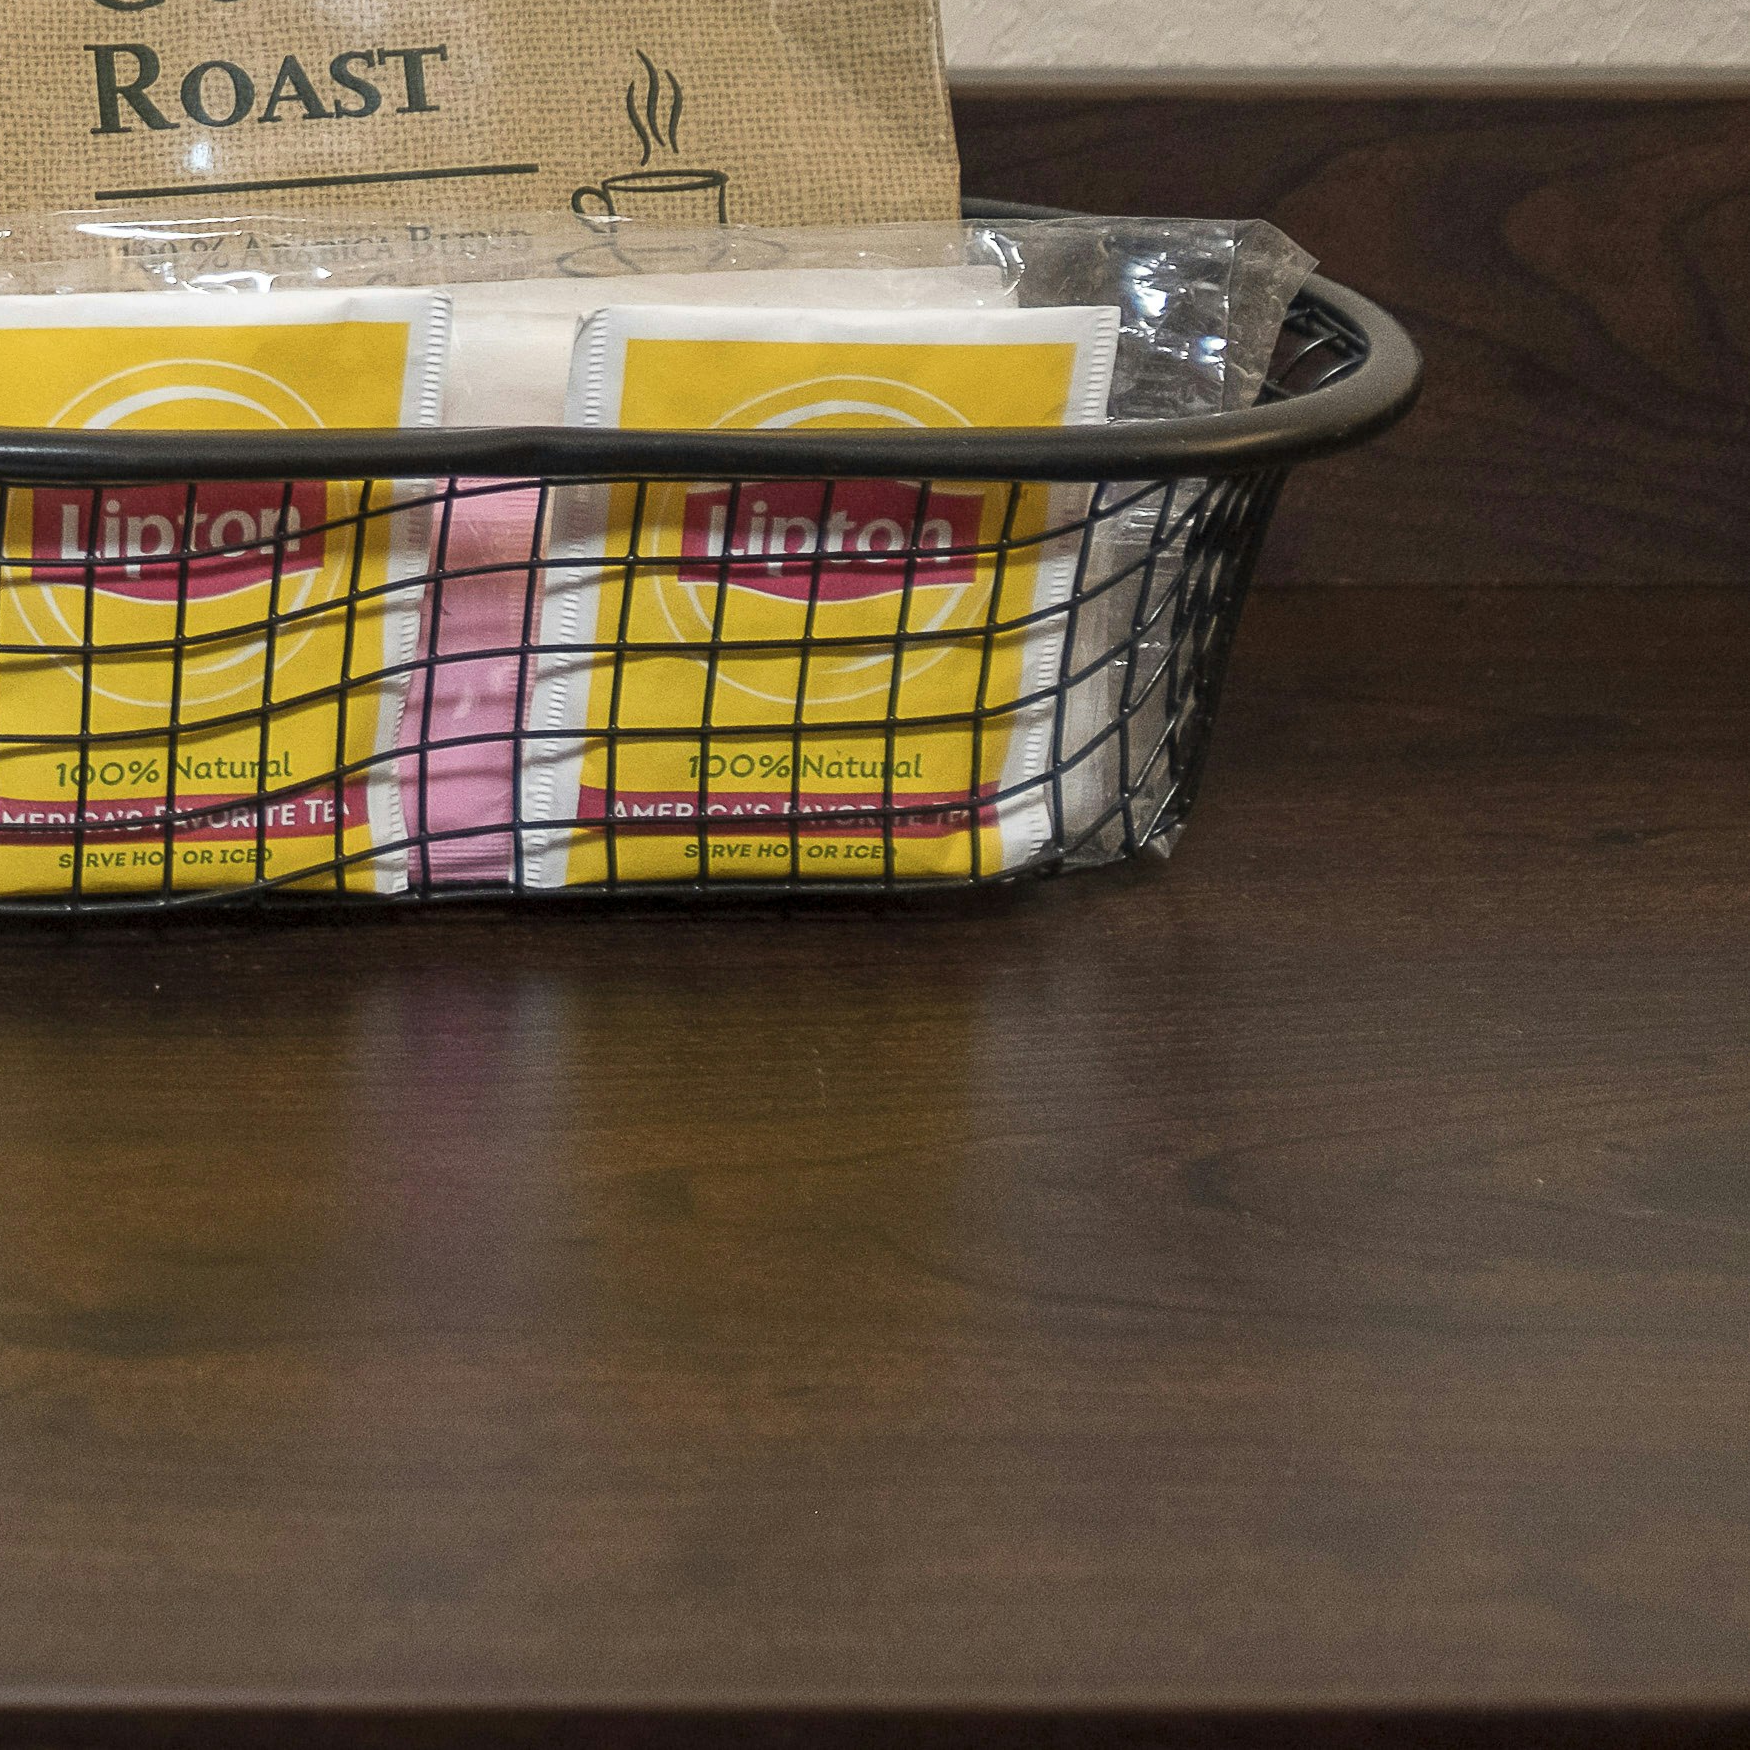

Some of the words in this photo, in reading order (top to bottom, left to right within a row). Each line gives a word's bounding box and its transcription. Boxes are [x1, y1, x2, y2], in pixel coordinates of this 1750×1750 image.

[83, 43, 448, 135] ROAST
[61, 500, 300, 580] Lipton
[707, 500, 953, 578] Lipton
[55, 758, 160, 788] 100%
[171, 751, 293, 782] Natural
[687, 753, 791, 779] 100%
[59, 851, 127, 869] SRVE
[133, 850, 176, 867] HO
[182, 849, 213, 865] OR
[684, 843, 752, 859] SRVE
[757, 843, 802, 859] HO
[807, 844, 838, 859] OR
[844, 844, 897, 860] ICE
